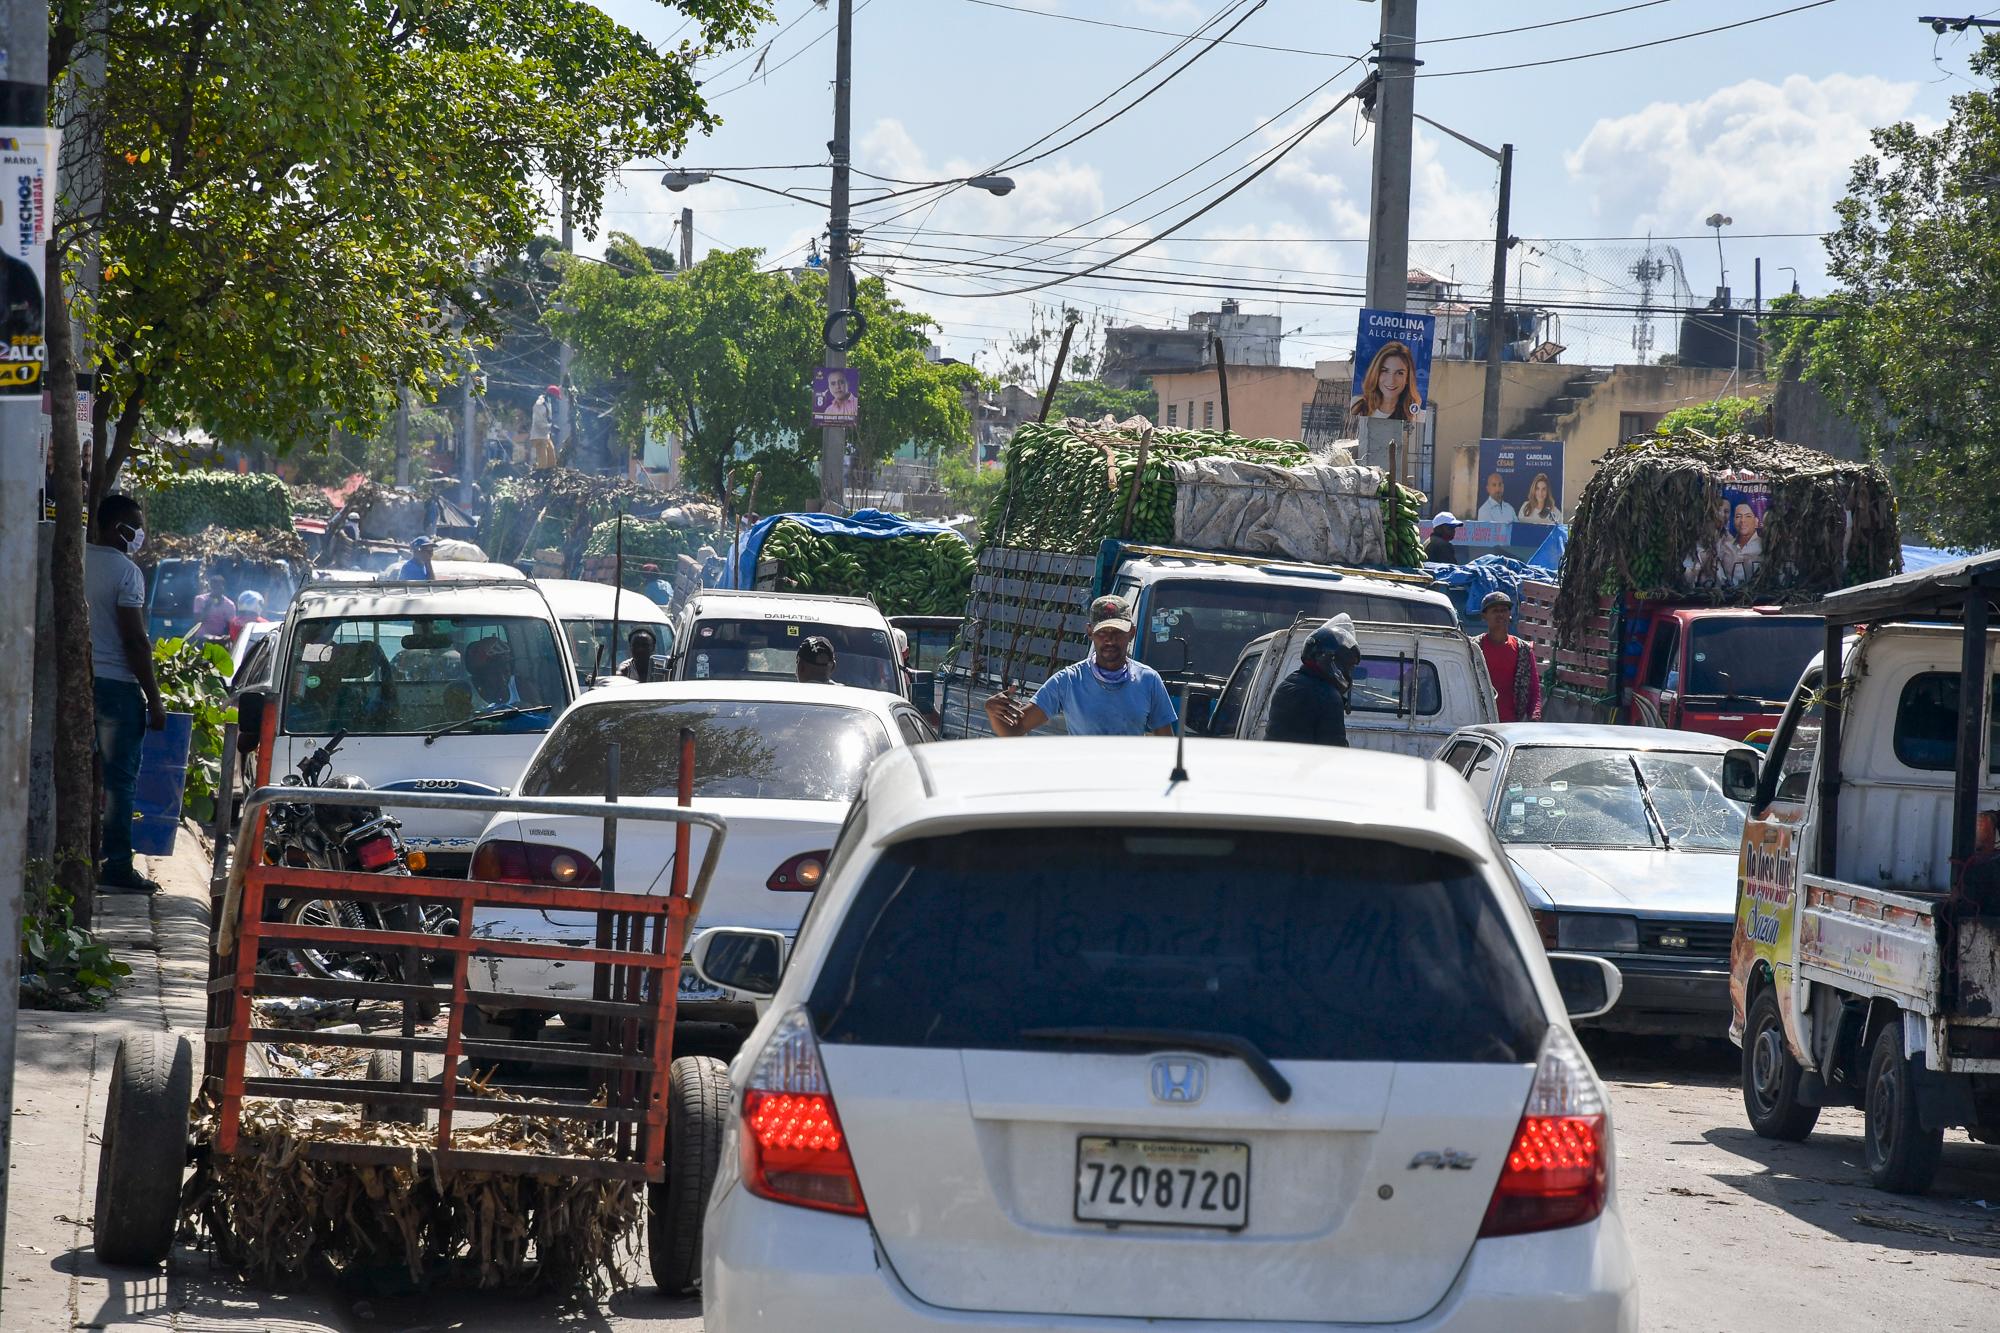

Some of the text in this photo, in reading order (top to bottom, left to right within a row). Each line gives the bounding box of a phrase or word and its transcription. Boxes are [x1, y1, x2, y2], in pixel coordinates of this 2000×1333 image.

[1369, 315, 1425, 331] CAROLINA
[1368, 329, 1424, 342] ALCALDESA
[1498, 452, 1515, 460] JULIO
[764, 613, 820, 622] DAIHATSU
[1746, 893, 1780, 945] Sazón
[1086, 1162, 1241, 1212] 7208720
